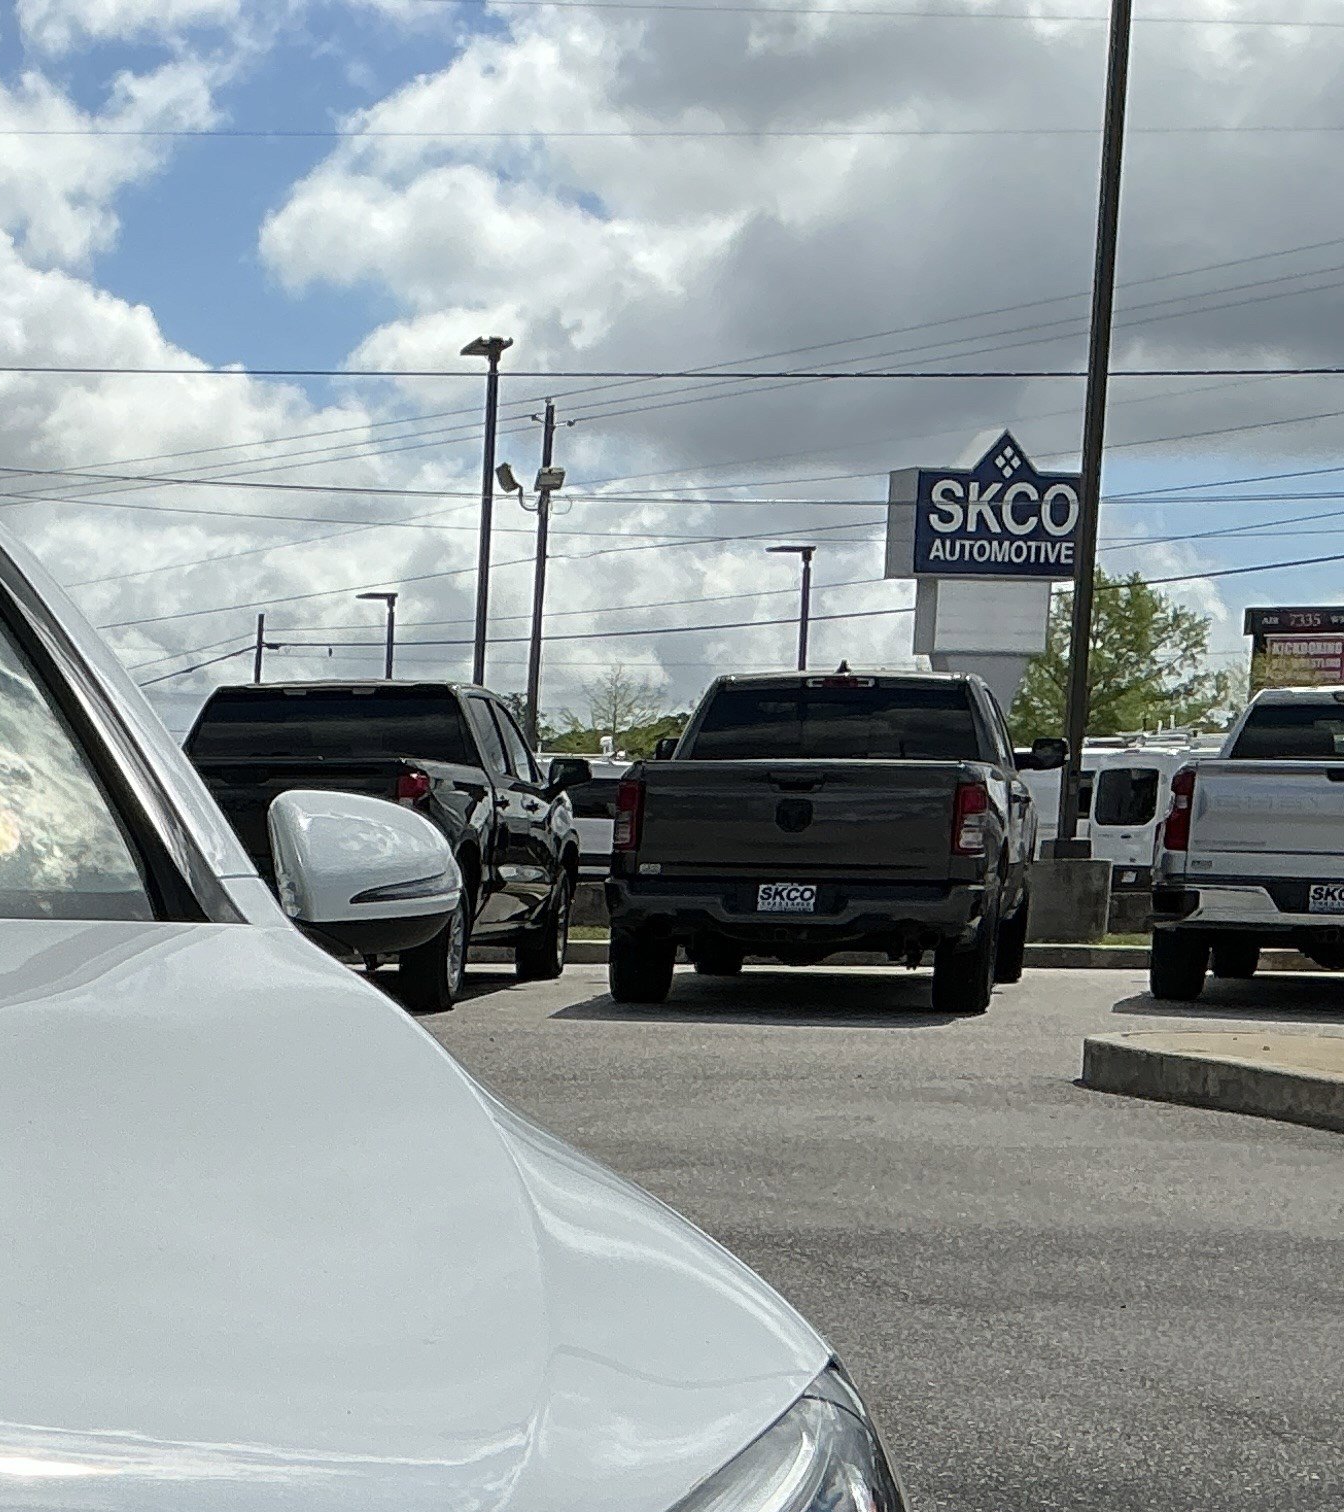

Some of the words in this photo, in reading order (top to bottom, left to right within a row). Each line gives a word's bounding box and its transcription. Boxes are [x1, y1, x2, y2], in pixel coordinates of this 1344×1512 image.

[928, 479, 1080, 537] SKCO
[928, 538, 1075, 565] AUTOMOTIVE
[760, 887, 815, 902] SKCO
